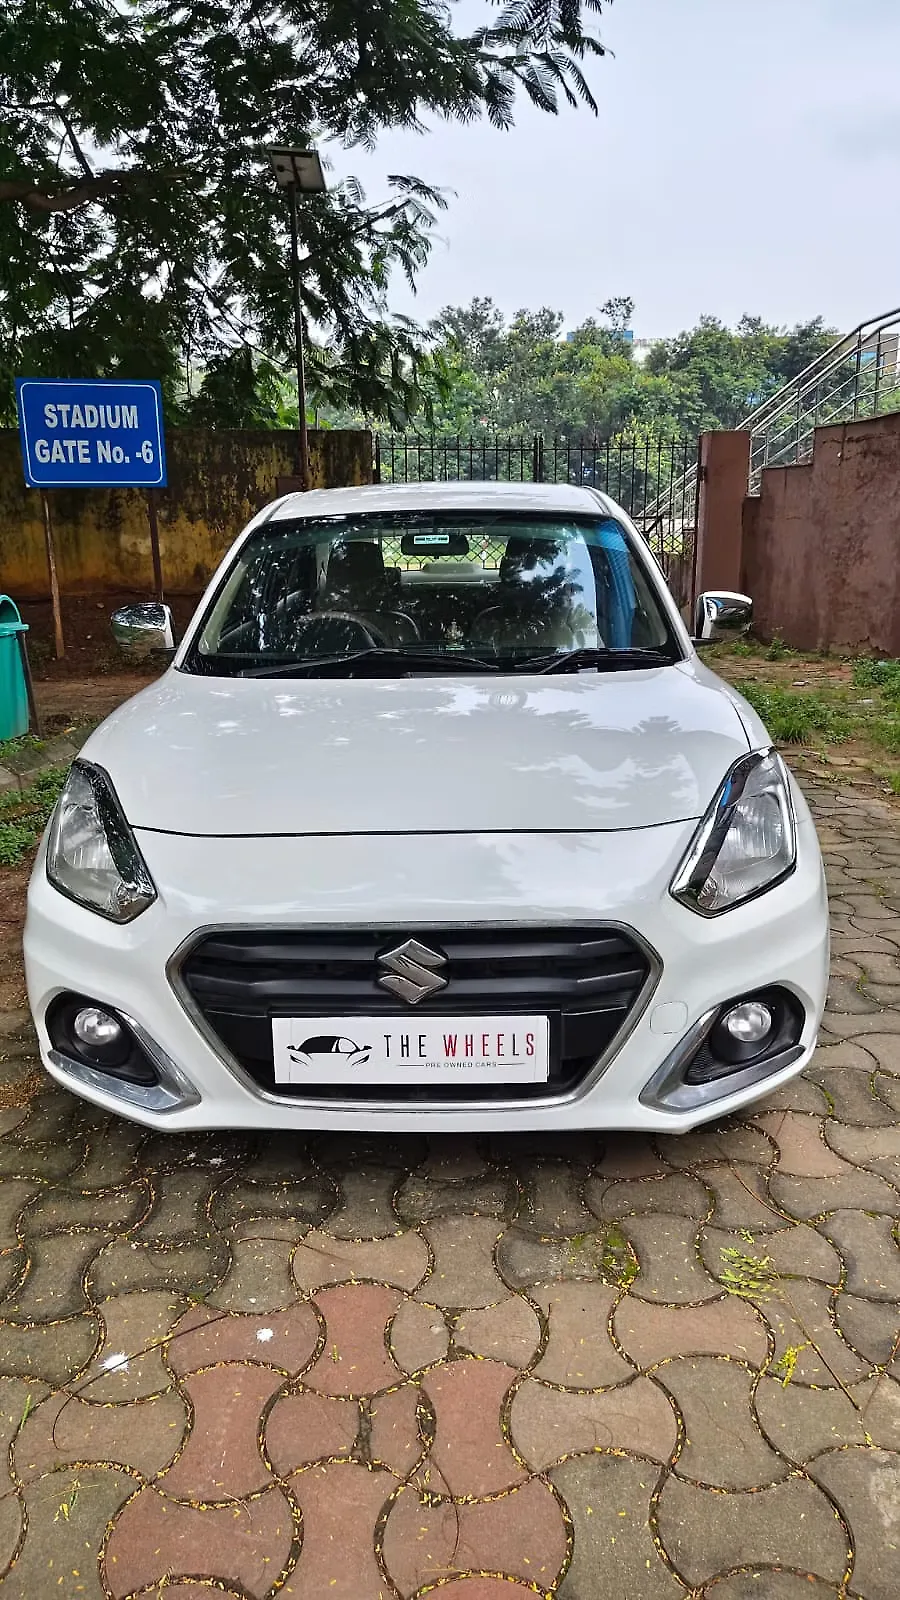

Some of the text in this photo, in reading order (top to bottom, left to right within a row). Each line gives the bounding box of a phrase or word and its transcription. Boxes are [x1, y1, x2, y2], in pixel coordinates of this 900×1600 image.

[44, 404, 139, 429] STADIUM
[35, 439, 91, 464] GATE
[97, 440, 130, 464] No.
[383, 1033, 535, 1058] THE WHEELS
